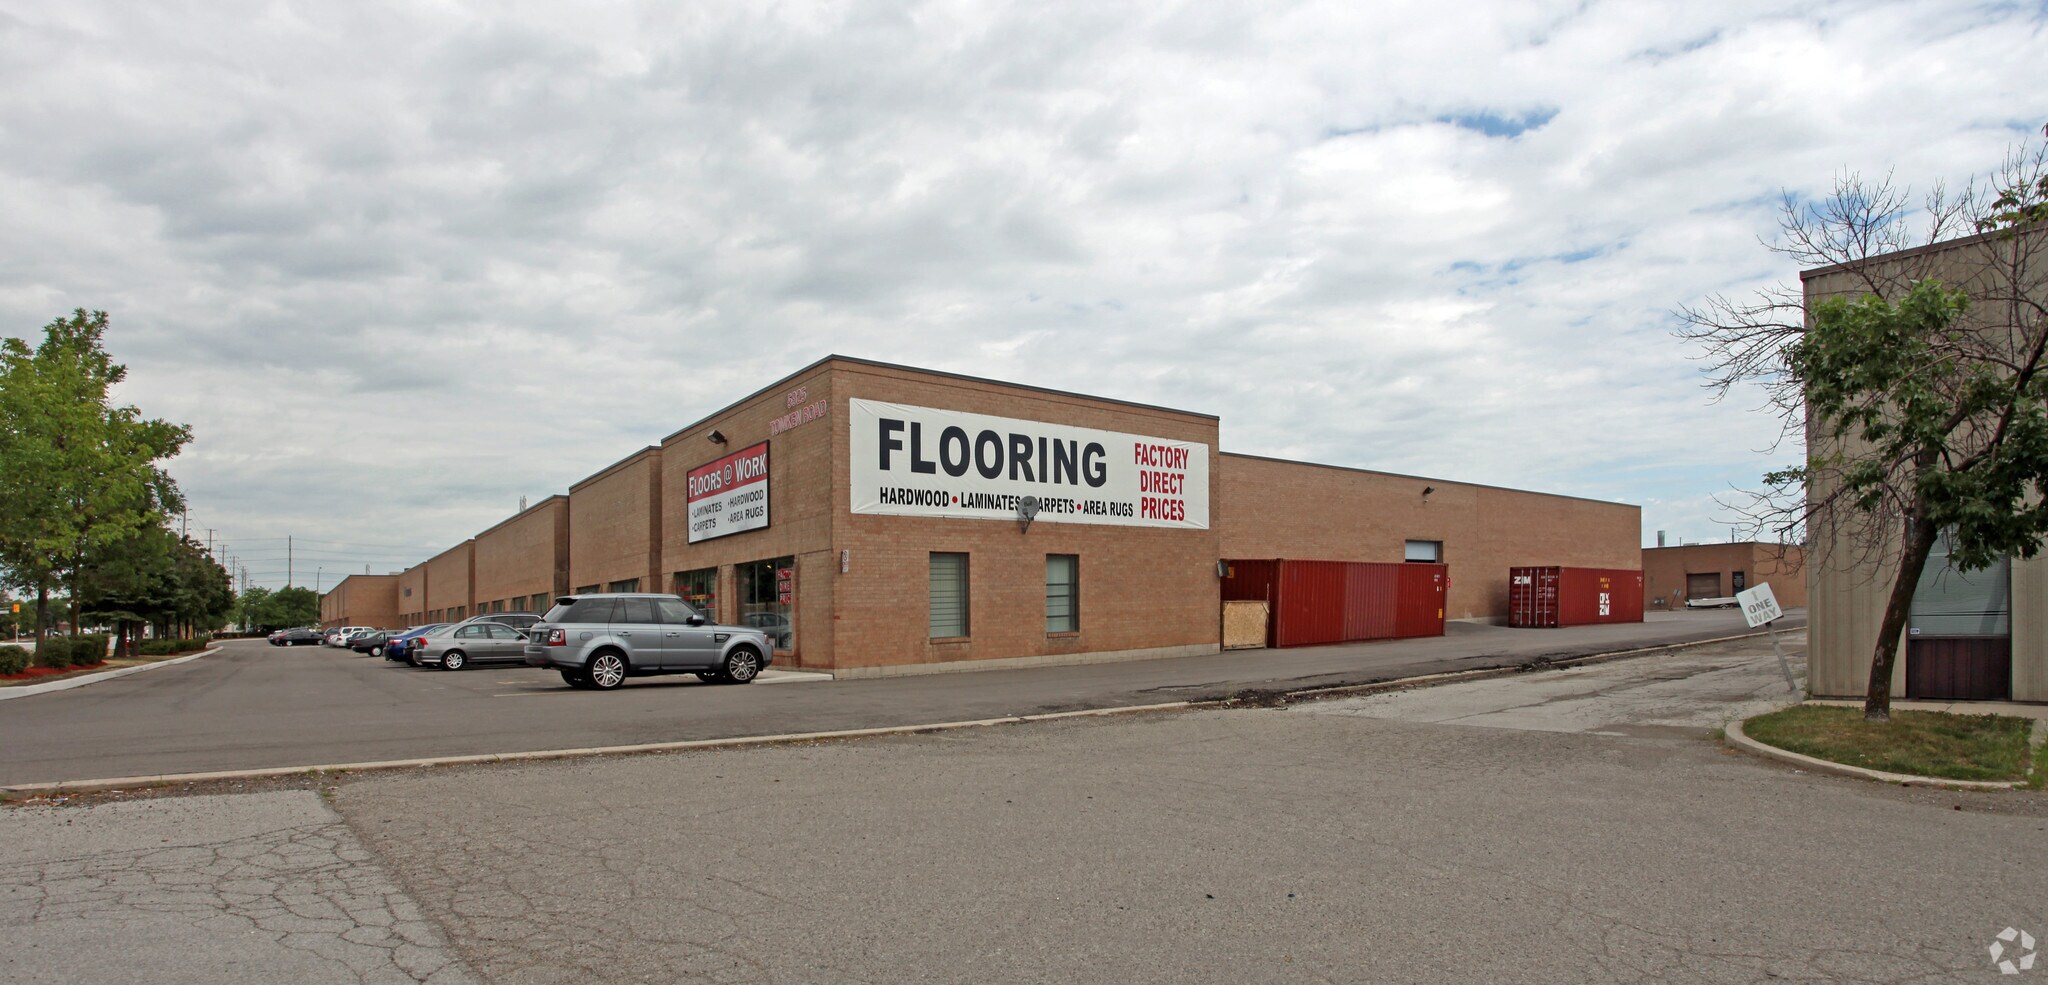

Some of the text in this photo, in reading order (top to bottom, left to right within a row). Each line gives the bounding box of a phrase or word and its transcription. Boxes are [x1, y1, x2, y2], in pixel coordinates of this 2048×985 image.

[803, 399, 827, 424] ROAD
[878, 417, 1107, 488] FLOORING
[1134, 442, 1189, 469] FACTORY
[689, 452, 767, 497] FLOORS @ WORK
[1140, 470, 1185, 495] DIRECT
[693, 501, 722, 518] LAMINATES
[729, 489, 764, 508] HARDWOOD
[879, 486, 949, 508] HARDWOOD
[1038, 496, 1075, 515] ARPETS
[1083, 500, 1107, 516] AREA
[1110, 501, 1134, 518] RUGS
[1141, 496, 1185, 522] PRICES
[693, 518, 716, 533] CARPETS
[729, 505, 764, 524] AREA RUGS
[1748, 598, 1773, 614] ONE
[1750, 607, 1777, 625] WAY
